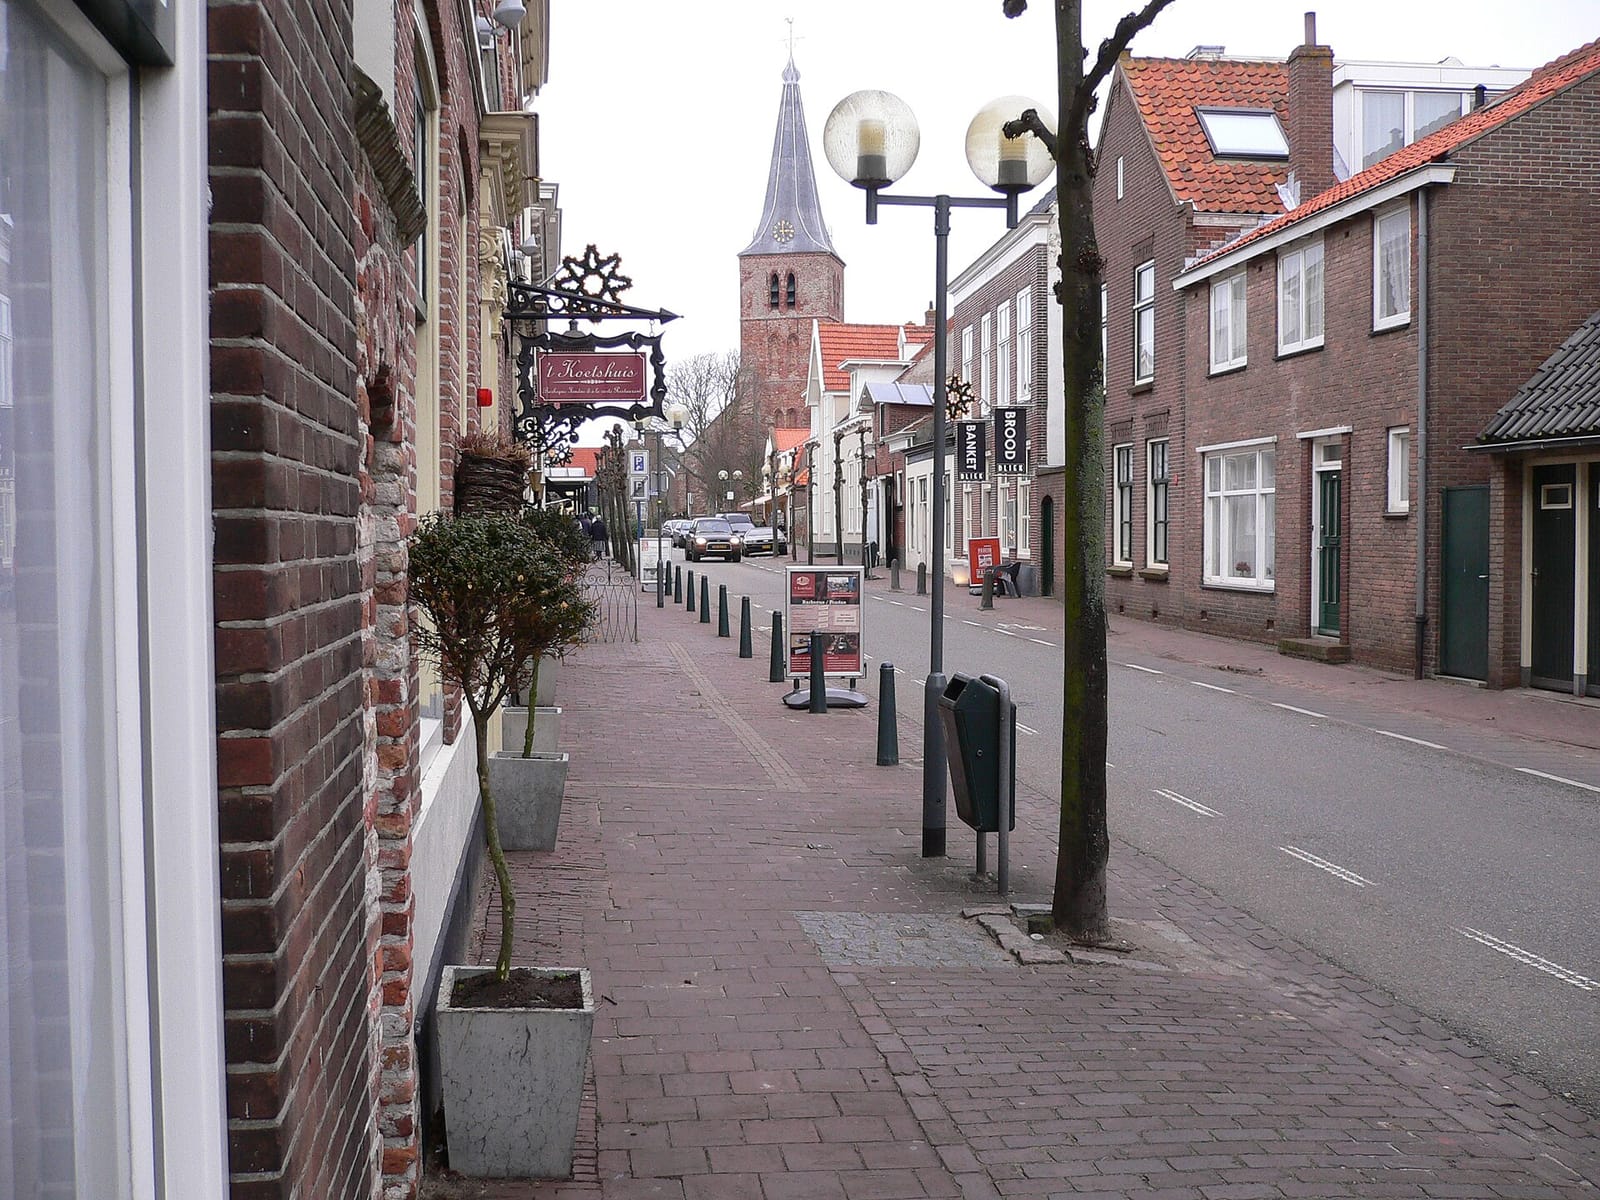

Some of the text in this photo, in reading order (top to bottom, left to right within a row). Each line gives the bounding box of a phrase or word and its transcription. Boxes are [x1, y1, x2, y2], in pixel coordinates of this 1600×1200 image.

[546, 360, 637, 378] 't Koetshuis
[966, 424, 977, 470] BANKET
[1004, 411, 1017, 460] BROOD
